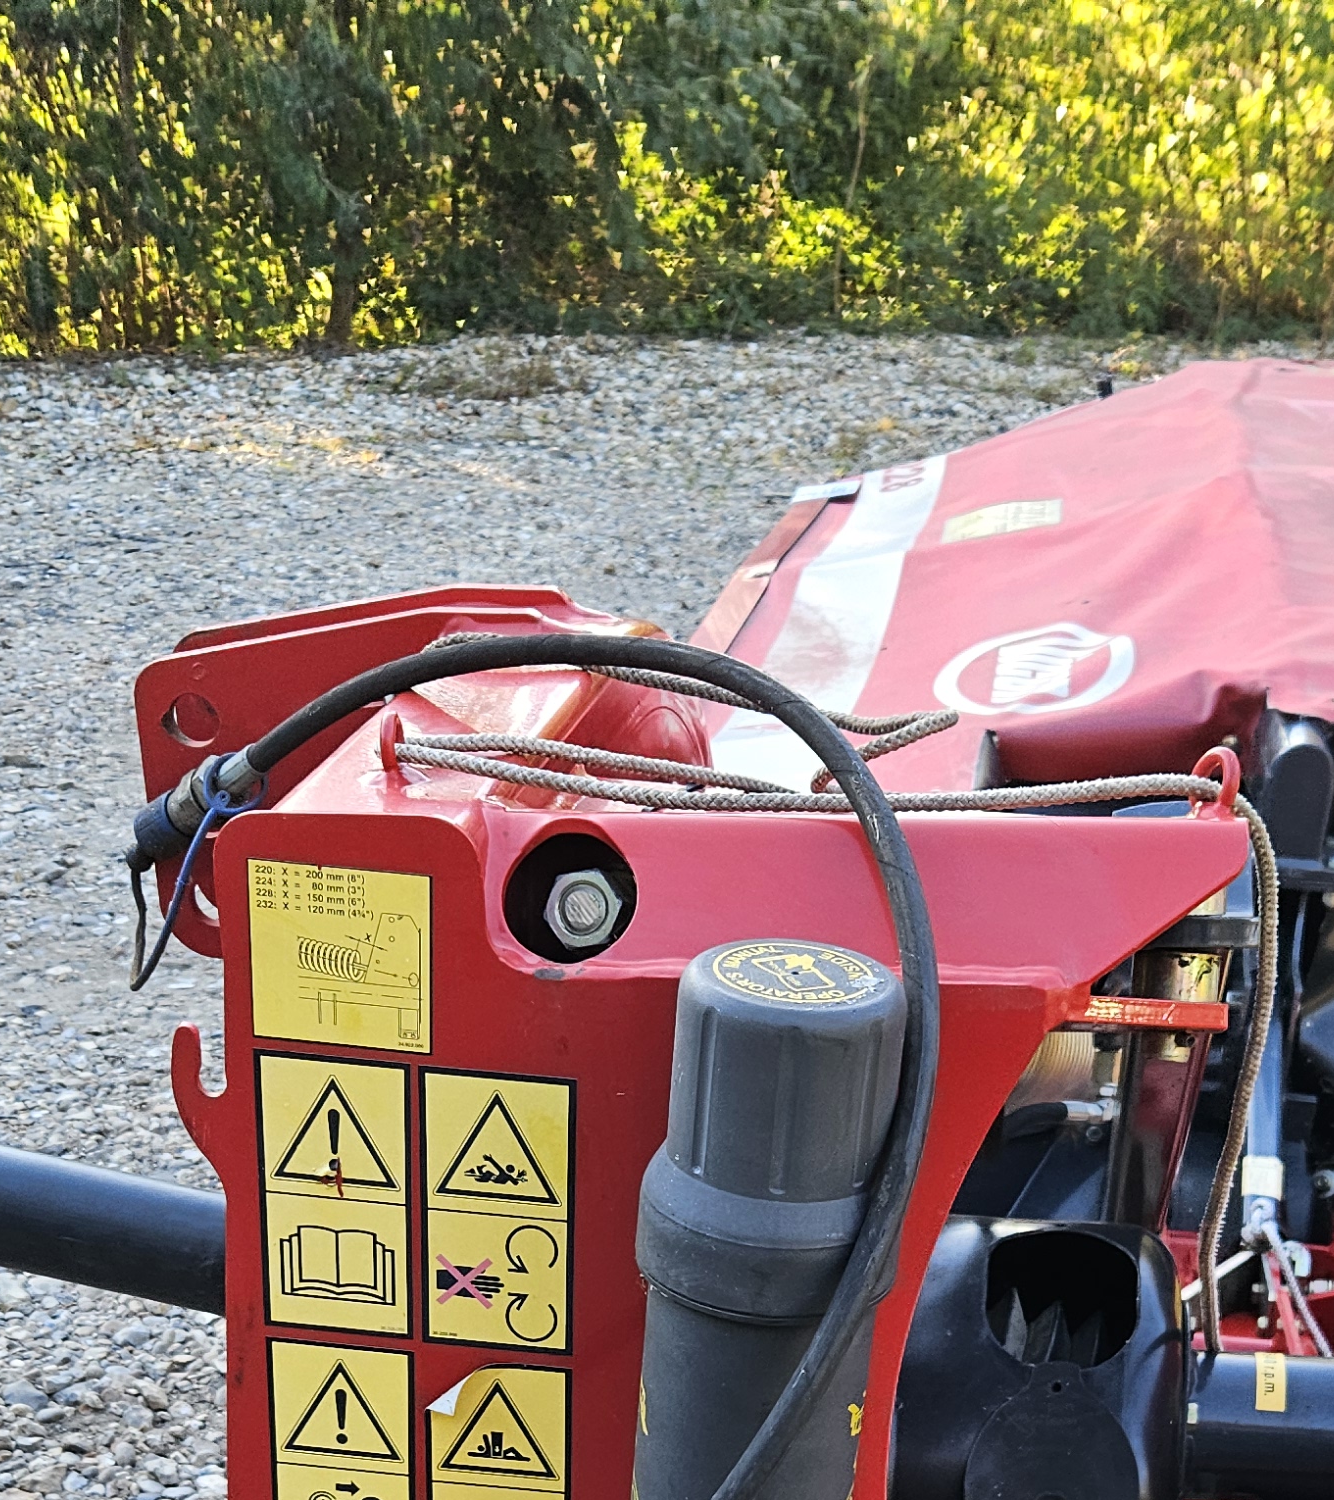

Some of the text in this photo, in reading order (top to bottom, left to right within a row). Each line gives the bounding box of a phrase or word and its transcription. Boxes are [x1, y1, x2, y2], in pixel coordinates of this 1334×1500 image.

[255, 865, 276, 876] 220:
[282, 867, 288, 876] X
[306, 870, 324, 880] 200
[326, 873, 344, 881] mm
[255, 876, 276, 887] 224:
[282, 879, 289, 888] X
[312, 882, 324, 891] 80
[326, 885, 344, 893] mm
[256, 888, 277, 899] 228:
[282, 890, 289, 899] X
[307, 893, 324, 903] 150
[327, 896, 345, 905] mm
[256, 900, 277, 910] 232:
[282, 901, 289, 911] X
[308, 905, 324, 915] 120
[327, 908, 345, 917] mm
[722, 945, 784, 969] MANUAL
